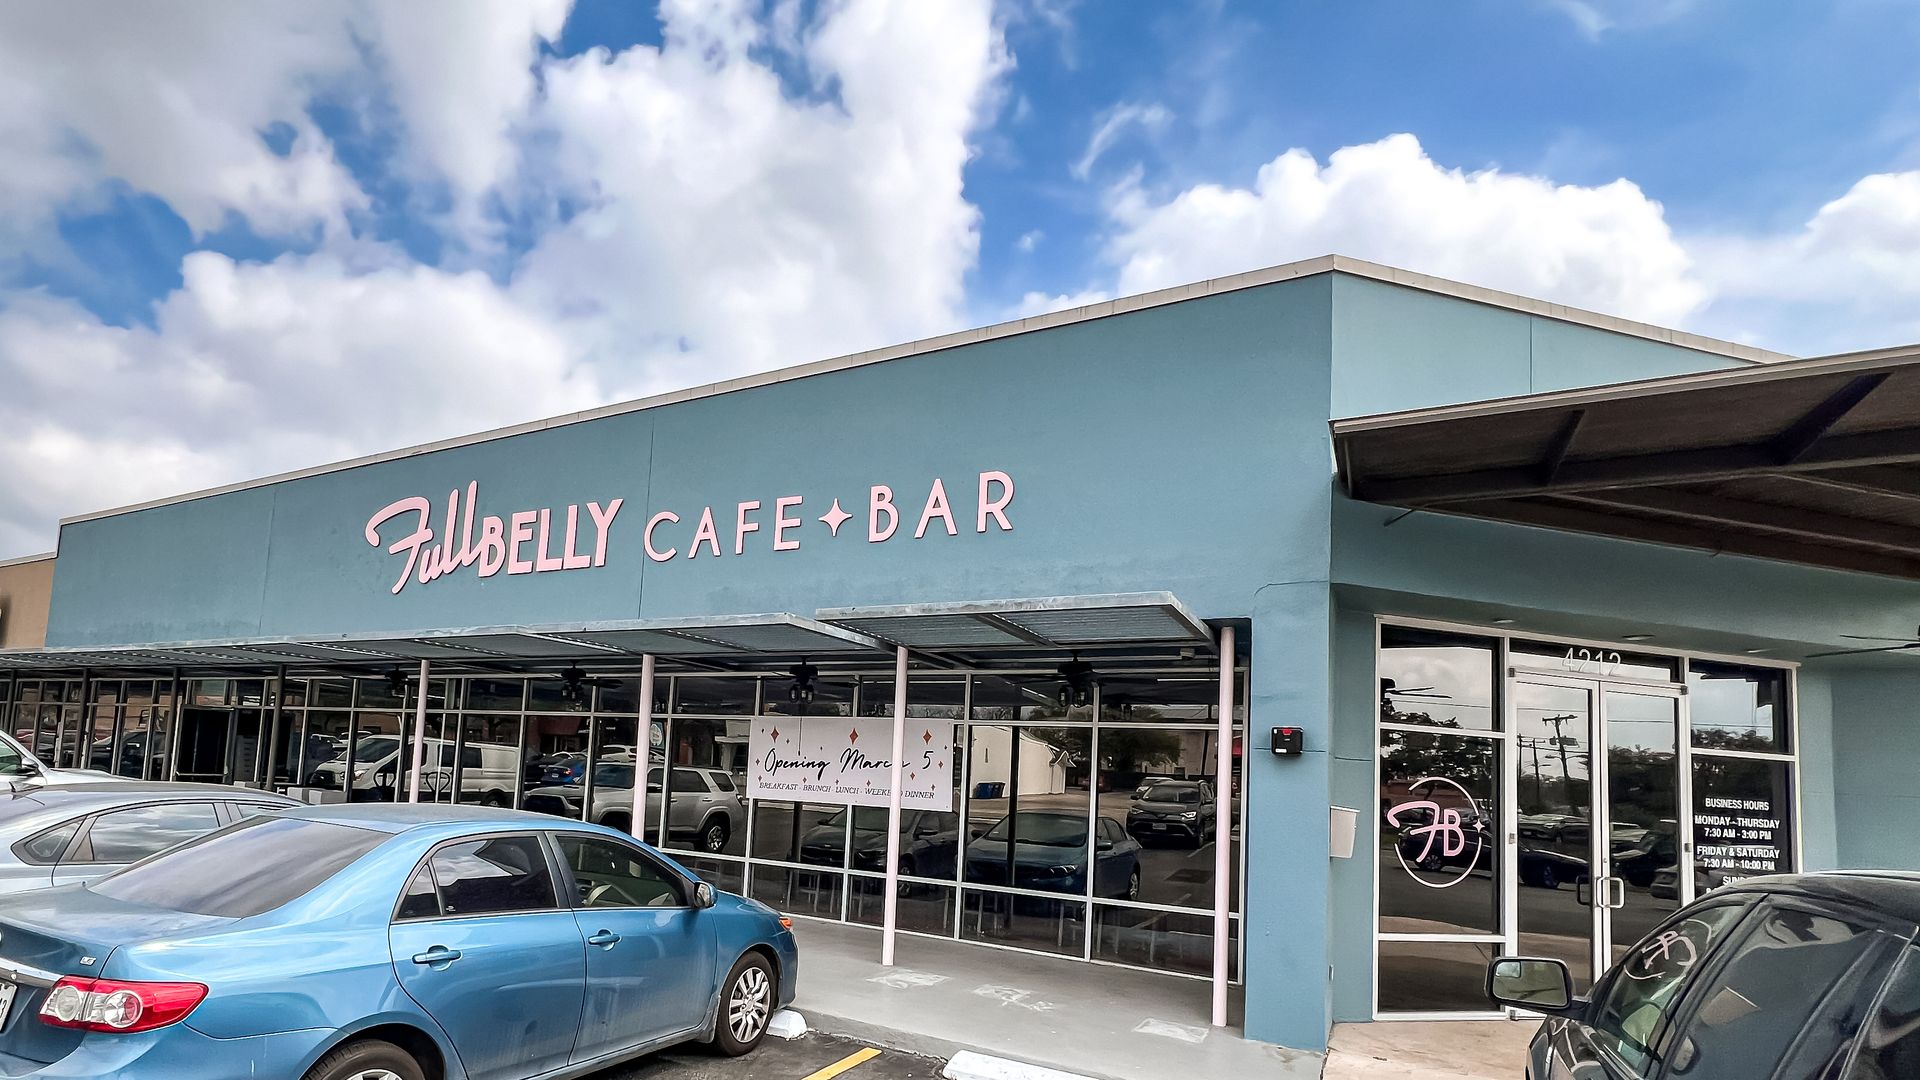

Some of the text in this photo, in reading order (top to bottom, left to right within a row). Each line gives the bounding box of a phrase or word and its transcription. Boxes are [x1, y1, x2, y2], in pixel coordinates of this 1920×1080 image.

[643, 495, 803, 562] CAFE
[868, 471, 1015, 543] BAR
[1561, 647, 1621, 676] 4212
[764, 747, 831, 781] Opening
[922, 750, 934, 770] 5
[759, 782, 935, 799] BREAKFAST BRUNCH LUNCH WEEKE DINNER
[1705, 798, 1770, 811] BUSINESS HOURS
[1694, 815, 1731, 826] MONDAY
[1736, 817, 1780, 828] THURSDAY
[1704, 828, 1721, 838] 7:30
[1722, 828, 1736, 838] AM
[1741, 830, 1758, 840] 3:00
[1759, 830, 1772, 840] PM
[1697, 846, 1780, 859] FRIDAY & SATURDAY
[1703, 858, 1720, 868] 7:30
[1721, 859, 1735, 868] AM
[1740, 860, 1761, 870] 10:00
[1762, 861, 1776, 871] PM
